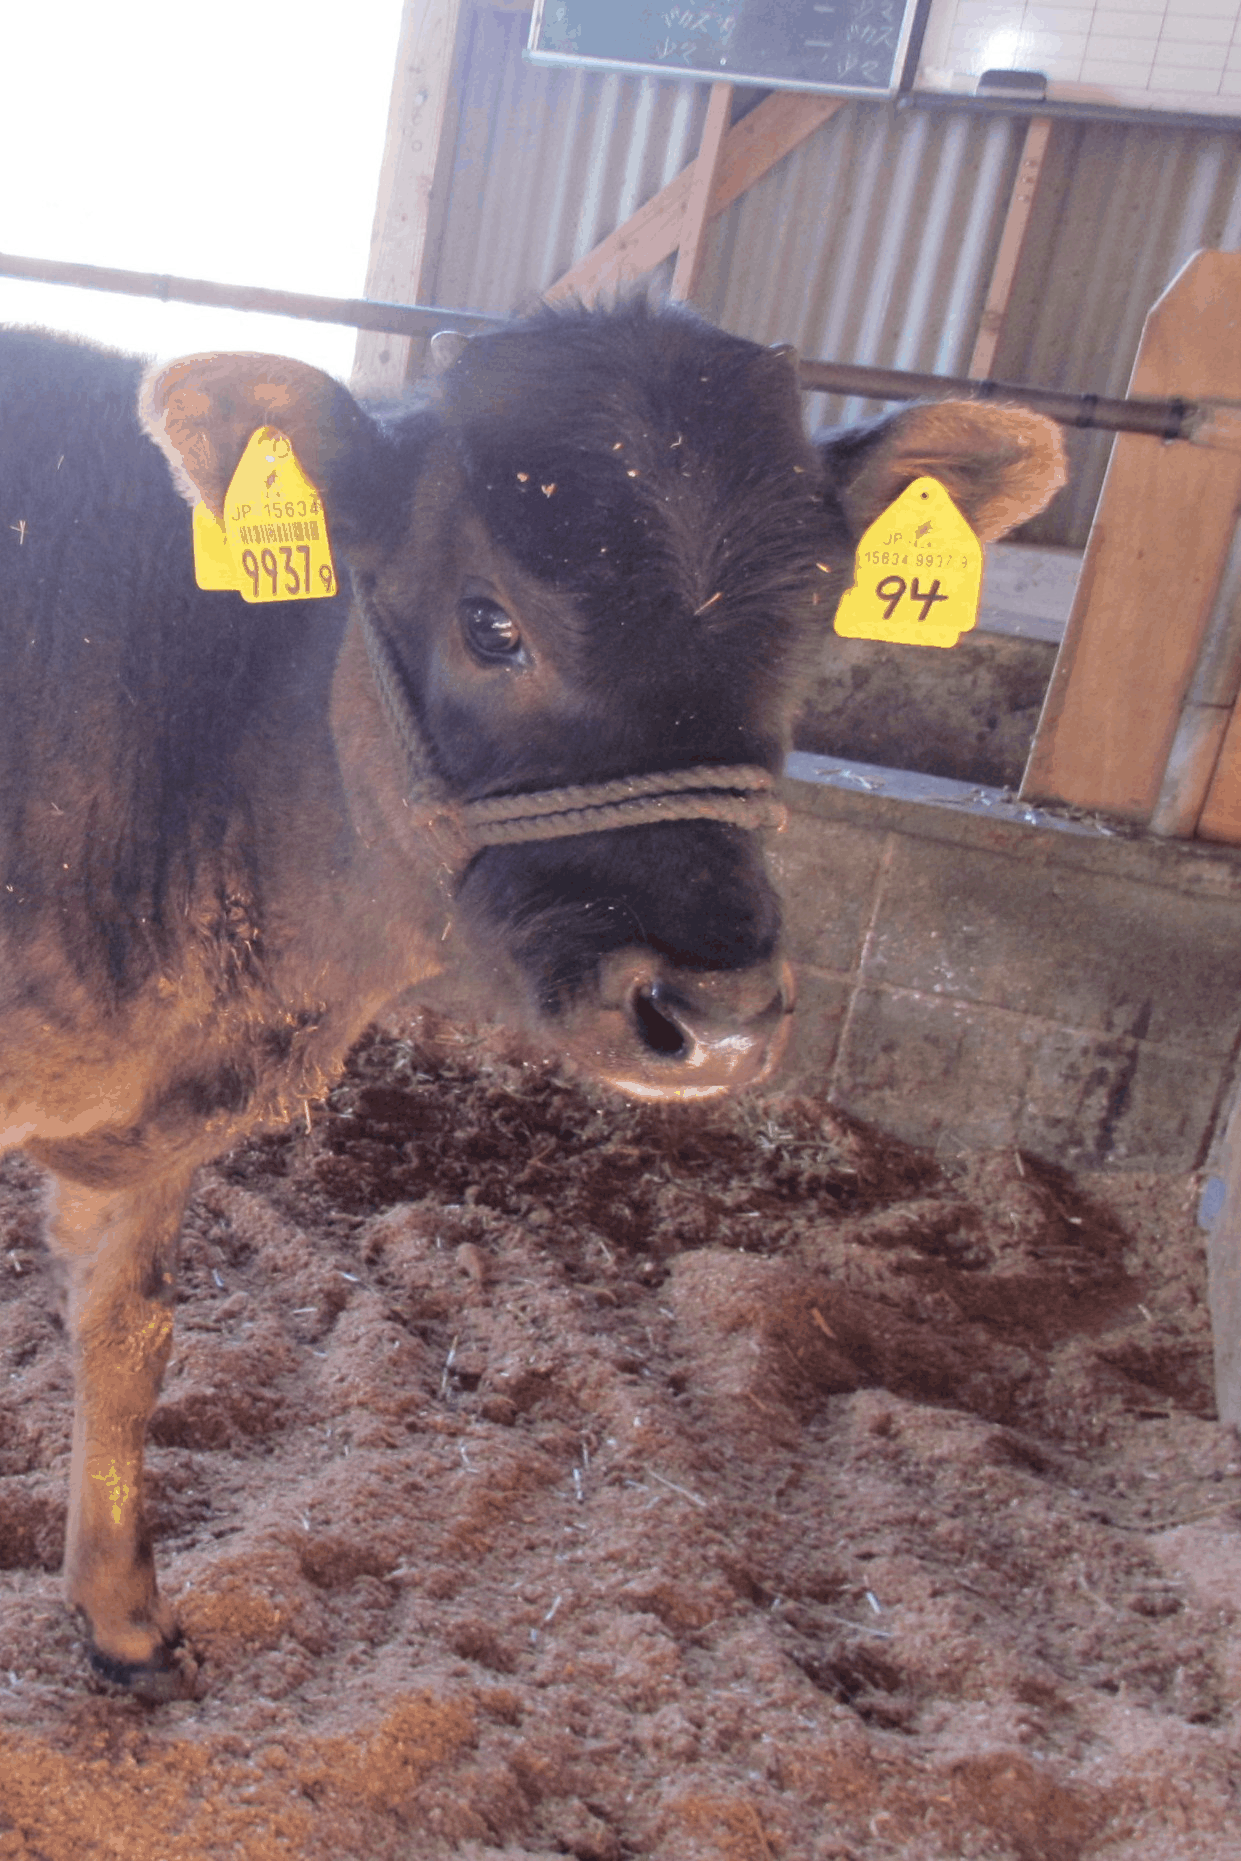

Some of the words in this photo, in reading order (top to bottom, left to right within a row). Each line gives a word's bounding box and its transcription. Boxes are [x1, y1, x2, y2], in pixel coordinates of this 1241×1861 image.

[232, 504, 252, 521] JP
[263, 500, 321, 519] 15634
[241, 544, 311, 598] 9937
[318, 564, 333, 594] 9
[875, 574, 949, 622] 94
